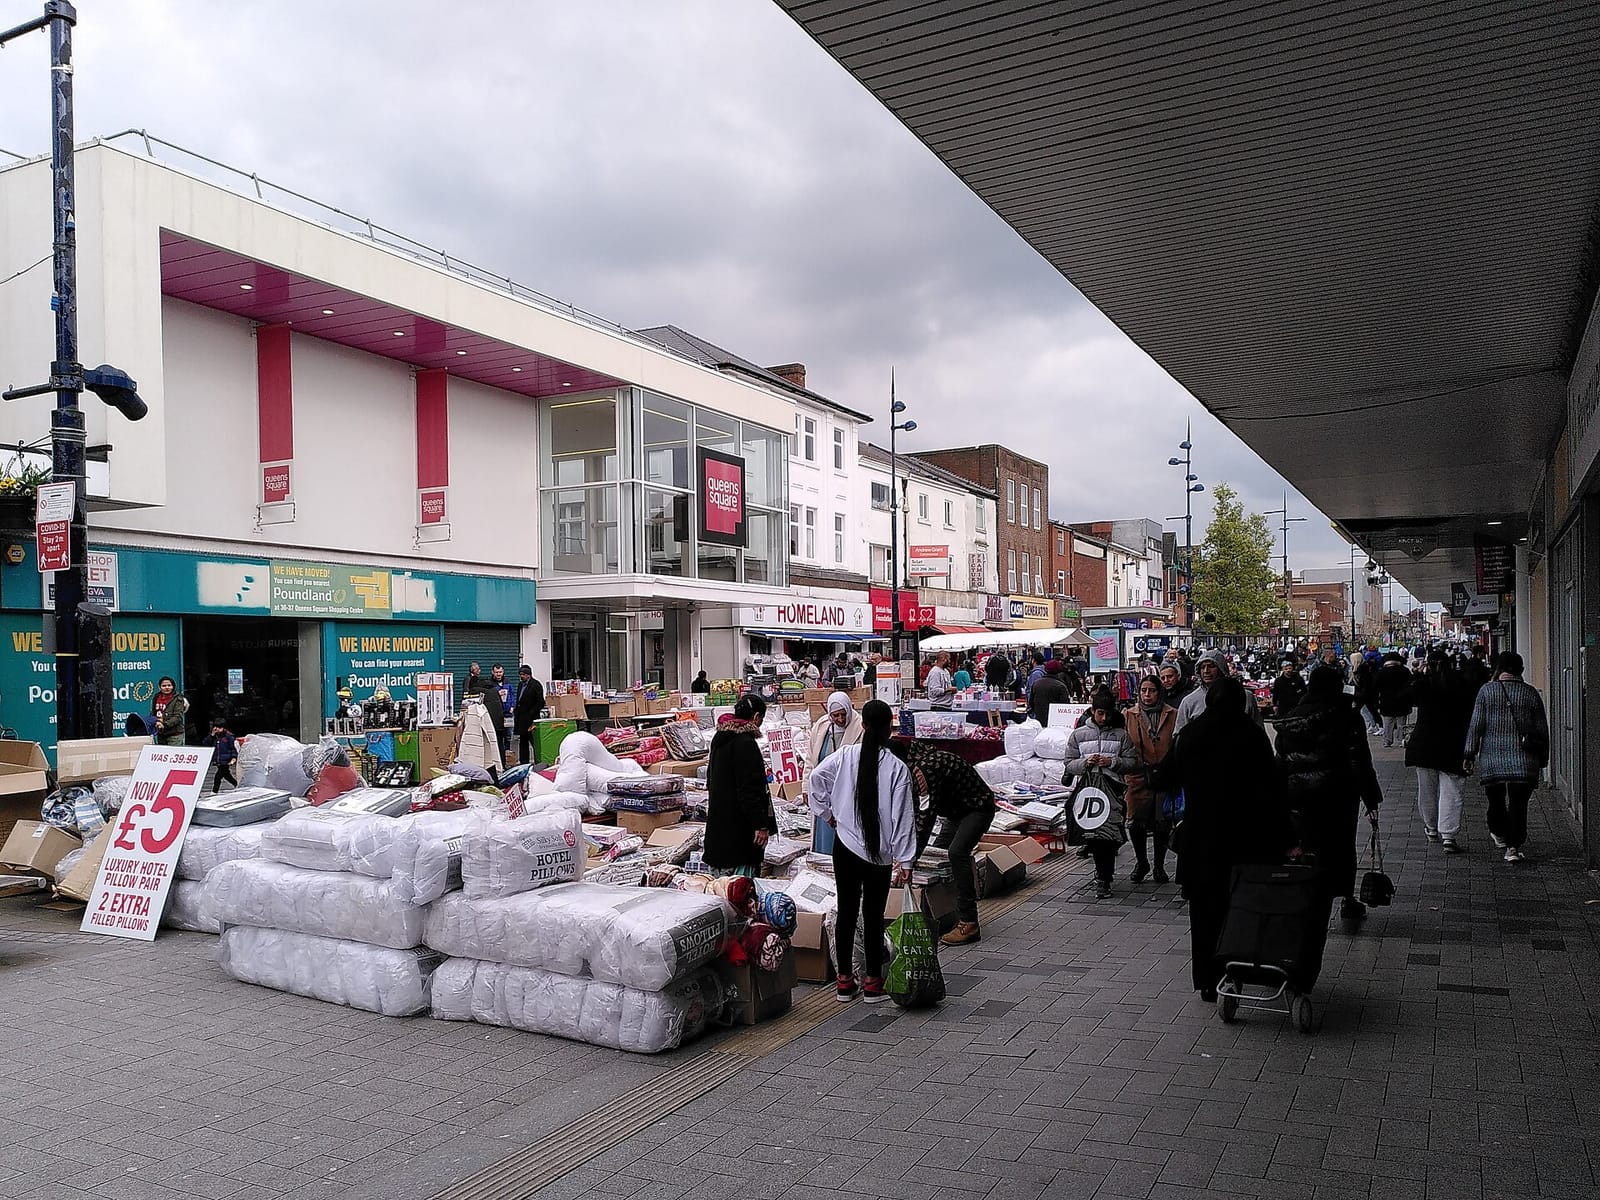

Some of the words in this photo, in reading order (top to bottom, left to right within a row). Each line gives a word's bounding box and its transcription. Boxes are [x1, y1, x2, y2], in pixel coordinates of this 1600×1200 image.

[265, 473, 289, 484] queens
[266, 481, 288, 491] square
[708, 477, 739, 496] queens
[422, 498, 444, 507] queens
[709, 491, 738, 509] square
[423, 505, 443, 514] square
[40, 523, 66, 533] COVID-19
[42, 536, 55, 545] Stay
[55, 535, 64, 543] 2m
[46, 544, 61, 553] apart
[87, 556, 113, 566] SHOP
[88, 568, 111, 582] ET
[273, 566, 285, 575] WE
[286, 567, 303, 576] HAVE
[304, 568, 330, 578] MOVED!
[273, 587, 332, 602] Poundland
[1010, 603, 1023, 616] CASH
[1455, 599, 1468, 607] LET
[777, 603, 845, 626] HOMELAND
[1024, 604, 1049, 617] GENERATOR
[12, 632, 43, 652] WE
[339, 636, 358, 653] WE
[361, 636, 391, 653] HAVE
[392, 636, 434, 653] MOVED!
[31, 660, 50, 672] You
[117, 659, 151, 671] nearest
[350, 659, 362, 668] You
[363, 660, 375, 668] can
[376, 659, 388, 668] find
[389, 660, 402, 669] your
[403, 658, 425, 667] nearest
[349, 673, 411, 688] Poundland
[783, 729, 792, 740] SET
[771, 741, 781, 752] ANY
[781, 740, 792, 751] SIZE
[150, 753, 169, 763] WAS
[169, 753, 199, 765] £39.99
[775, 751, 797, 785] £5
[130, 781, 160, 802] NOW
[508, 794, 522, 813] WITH
[623, 798, 644, 807] QUEEN
[1077, 797, 1105, 820] JD
[113, 769, 199, 854] £5
[447, 840, 462, 852] BH
[536, 836, 551, 845] Silky
[536, 850, 572, 866] HOTEL
[104, 858, 140, 876] LUXURY
[140, 862, 168, 877] HOTEL
[530, 863, 576, 881] PILLOWS
[103, 873, 139, 888] PILLOW
[139, 876, 161, 891] PAIR
[98, 892, 109, 911] 2
[110, 893, 151, 917] EXTRA
[90, 912, 116, 927] FILLED
[115, 915, 150, 932] PILLOWS
[679, 922, 722, 952] PILLOWS
[904, 928, 932, 937] WAIT
[686, 940, 717, 963] HOTEL
